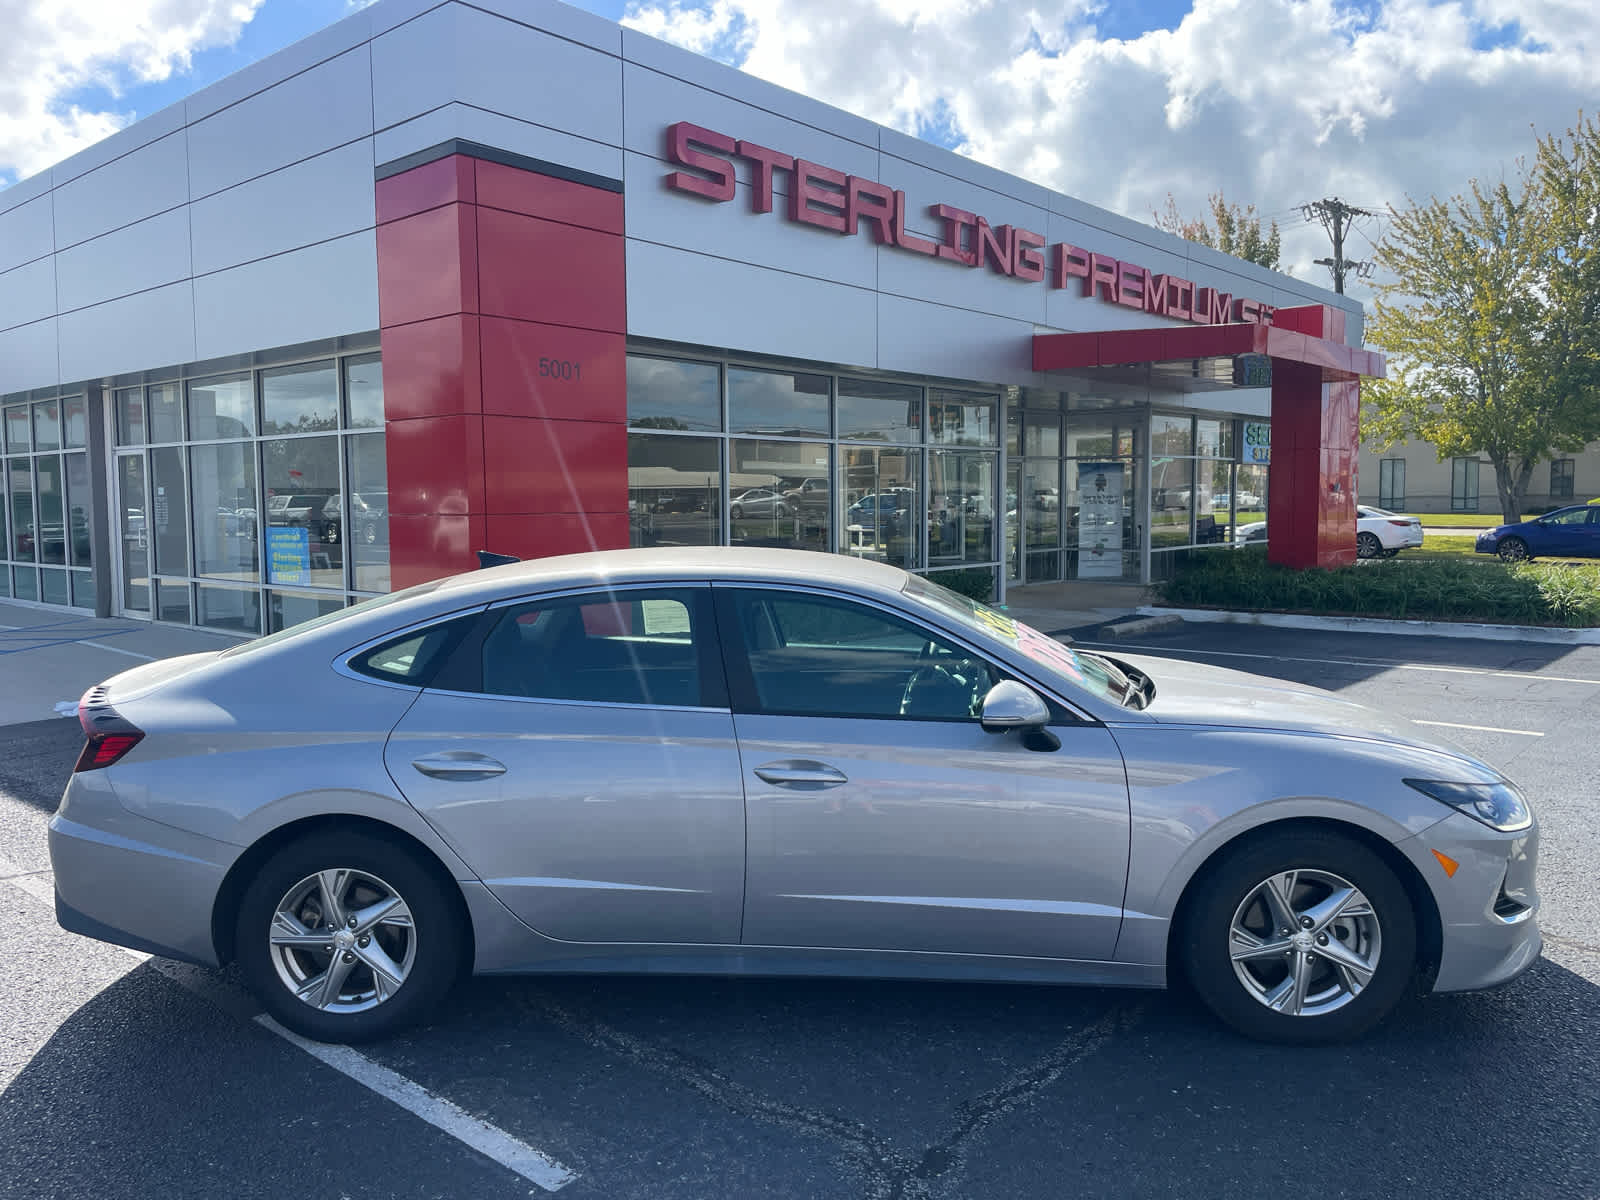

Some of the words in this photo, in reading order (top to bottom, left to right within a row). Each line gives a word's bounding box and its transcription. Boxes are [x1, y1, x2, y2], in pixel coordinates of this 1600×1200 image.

[666, 121, 1045, 283] STERLING
[1053, 242, 1233, 325] PREMIUM
[539, 357, 581, 381] 5001
